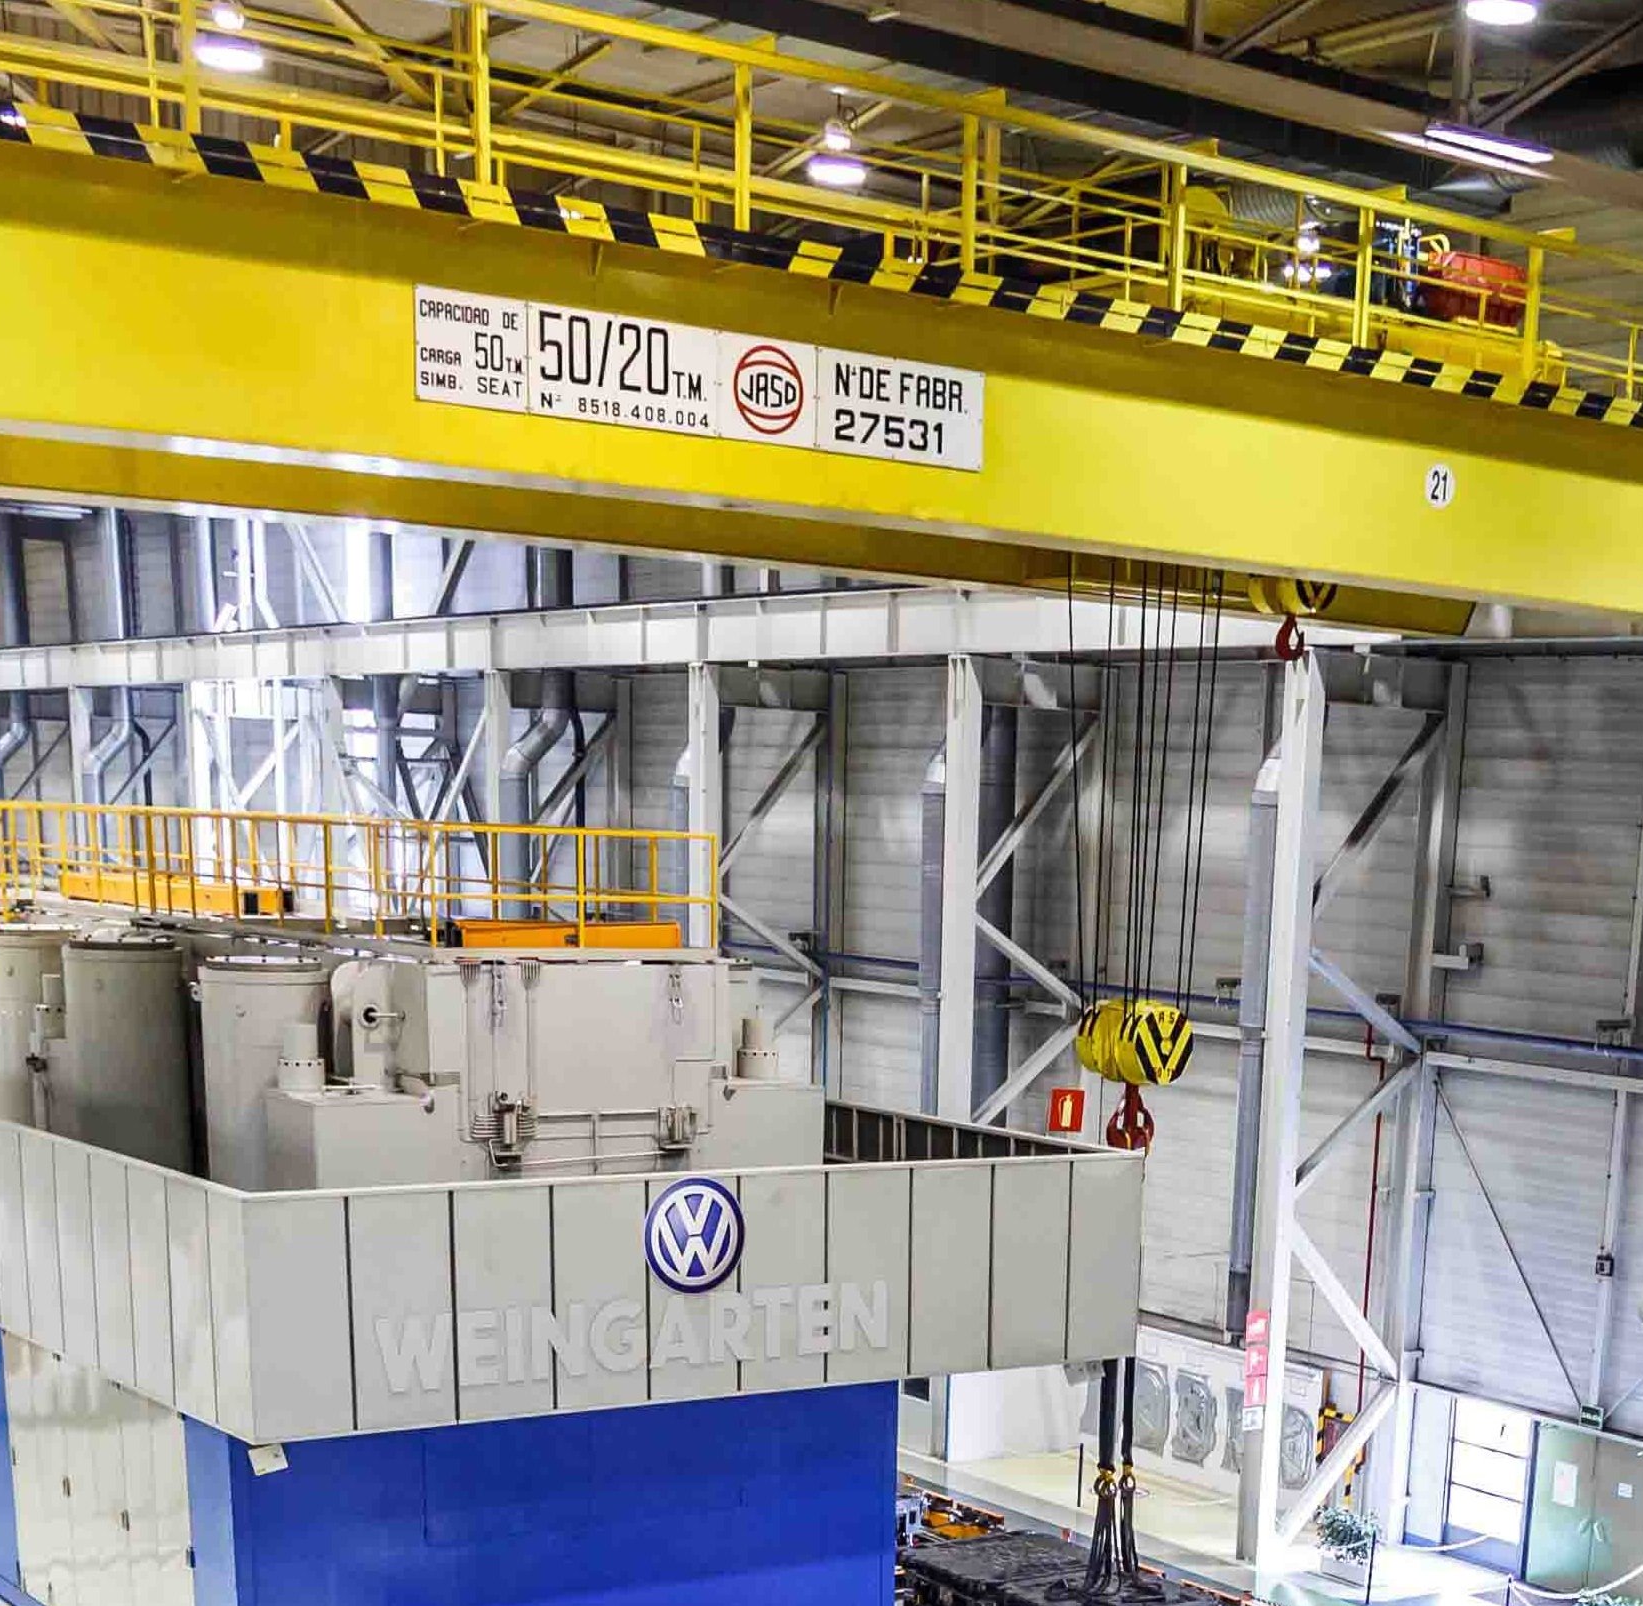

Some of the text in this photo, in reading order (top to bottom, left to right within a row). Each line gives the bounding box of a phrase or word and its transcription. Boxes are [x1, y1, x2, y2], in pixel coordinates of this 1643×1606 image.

[420, 298, 519, 331] CAPACIDAD DE
[420, 346, 462, 367] CARGA
[475, 331, 504, 372] 50
[539, 309, 669, 396] 50/20
[420, 370, 523, 398] SIMB. SEAT
[741, 372, 797, 408] JASO
[859, 366, 891, 402] DE
[900, 372, 968, 414] FABR.
[577, 396, 709, 429] 8518.408.004
[834, 408, 944, 455] 27531
[1430, 469, 1448, 500] 21
[373, 1280, 889, 1394] WEINGARTEN
